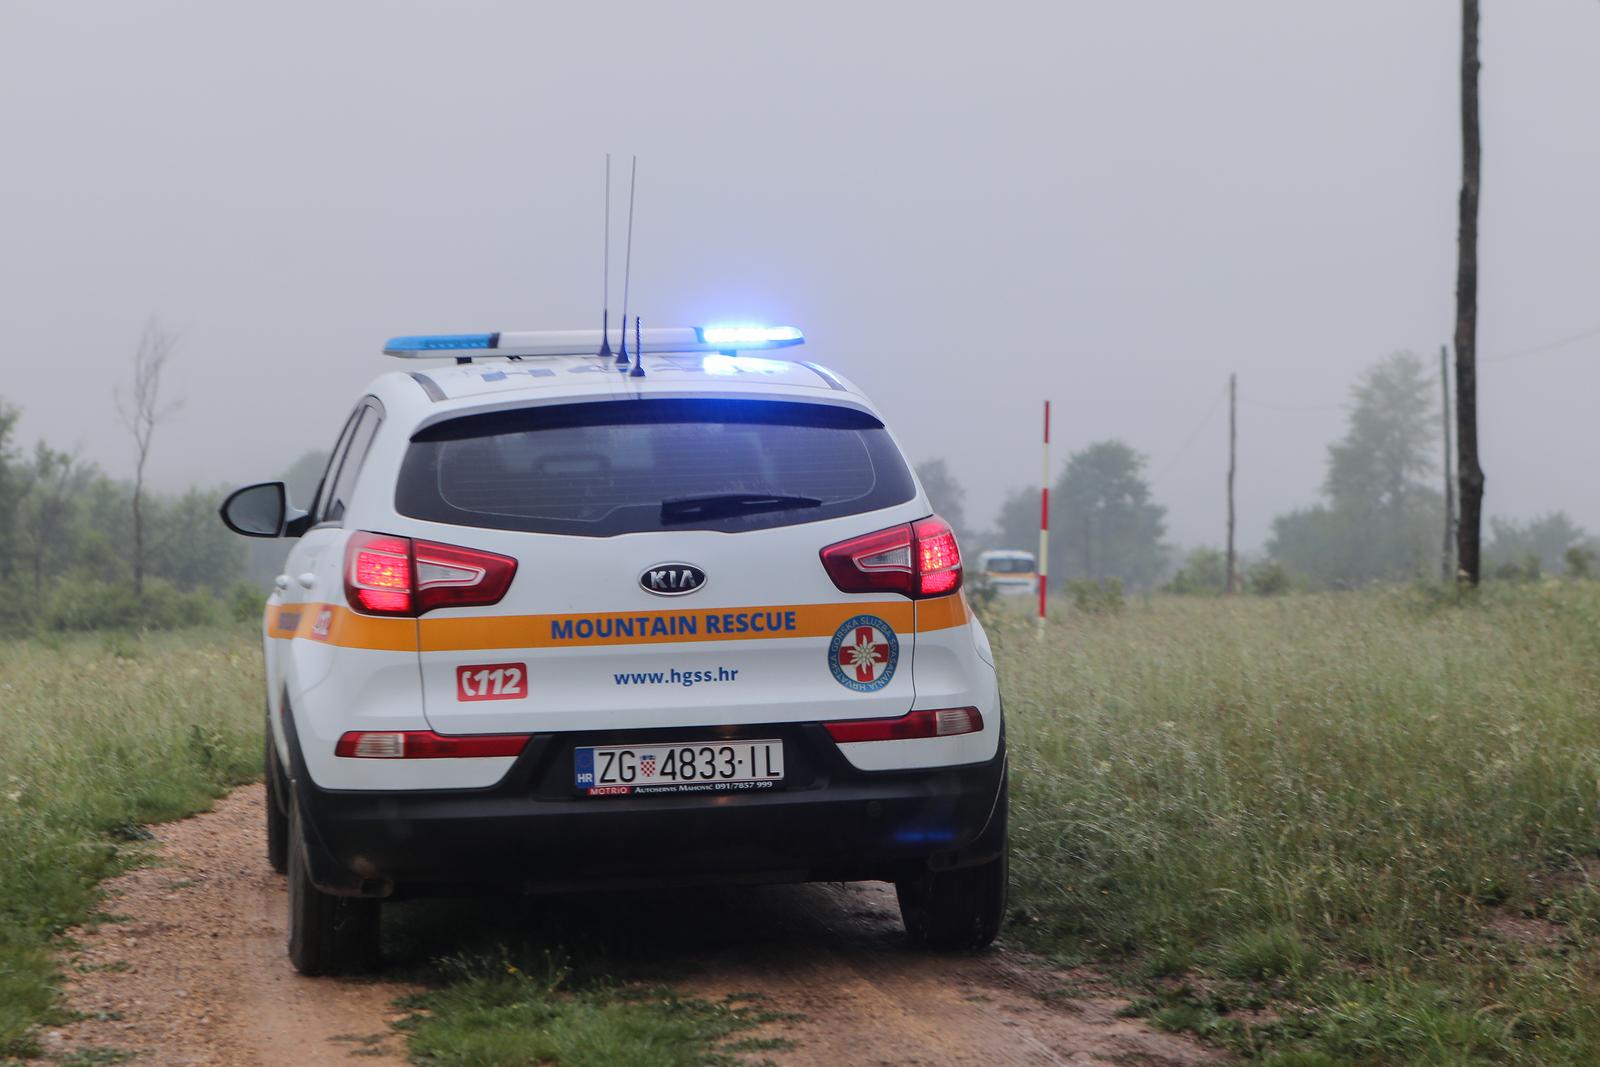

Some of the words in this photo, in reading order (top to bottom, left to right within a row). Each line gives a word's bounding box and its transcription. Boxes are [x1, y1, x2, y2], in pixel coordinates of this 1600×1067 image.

[649, 569, 697, 588] KIA
[551, 615, 697, 640] MOUNTAIN
[706, 611, 796, 634] RESCUE
[473, 667, 522, 696] 112
[614, 667, 739, 687] www.hgss.hr
[598, 750, 636, 784] ZG
[577, 773, 593, 783] HR
[756, 780, 773, 788] 999
